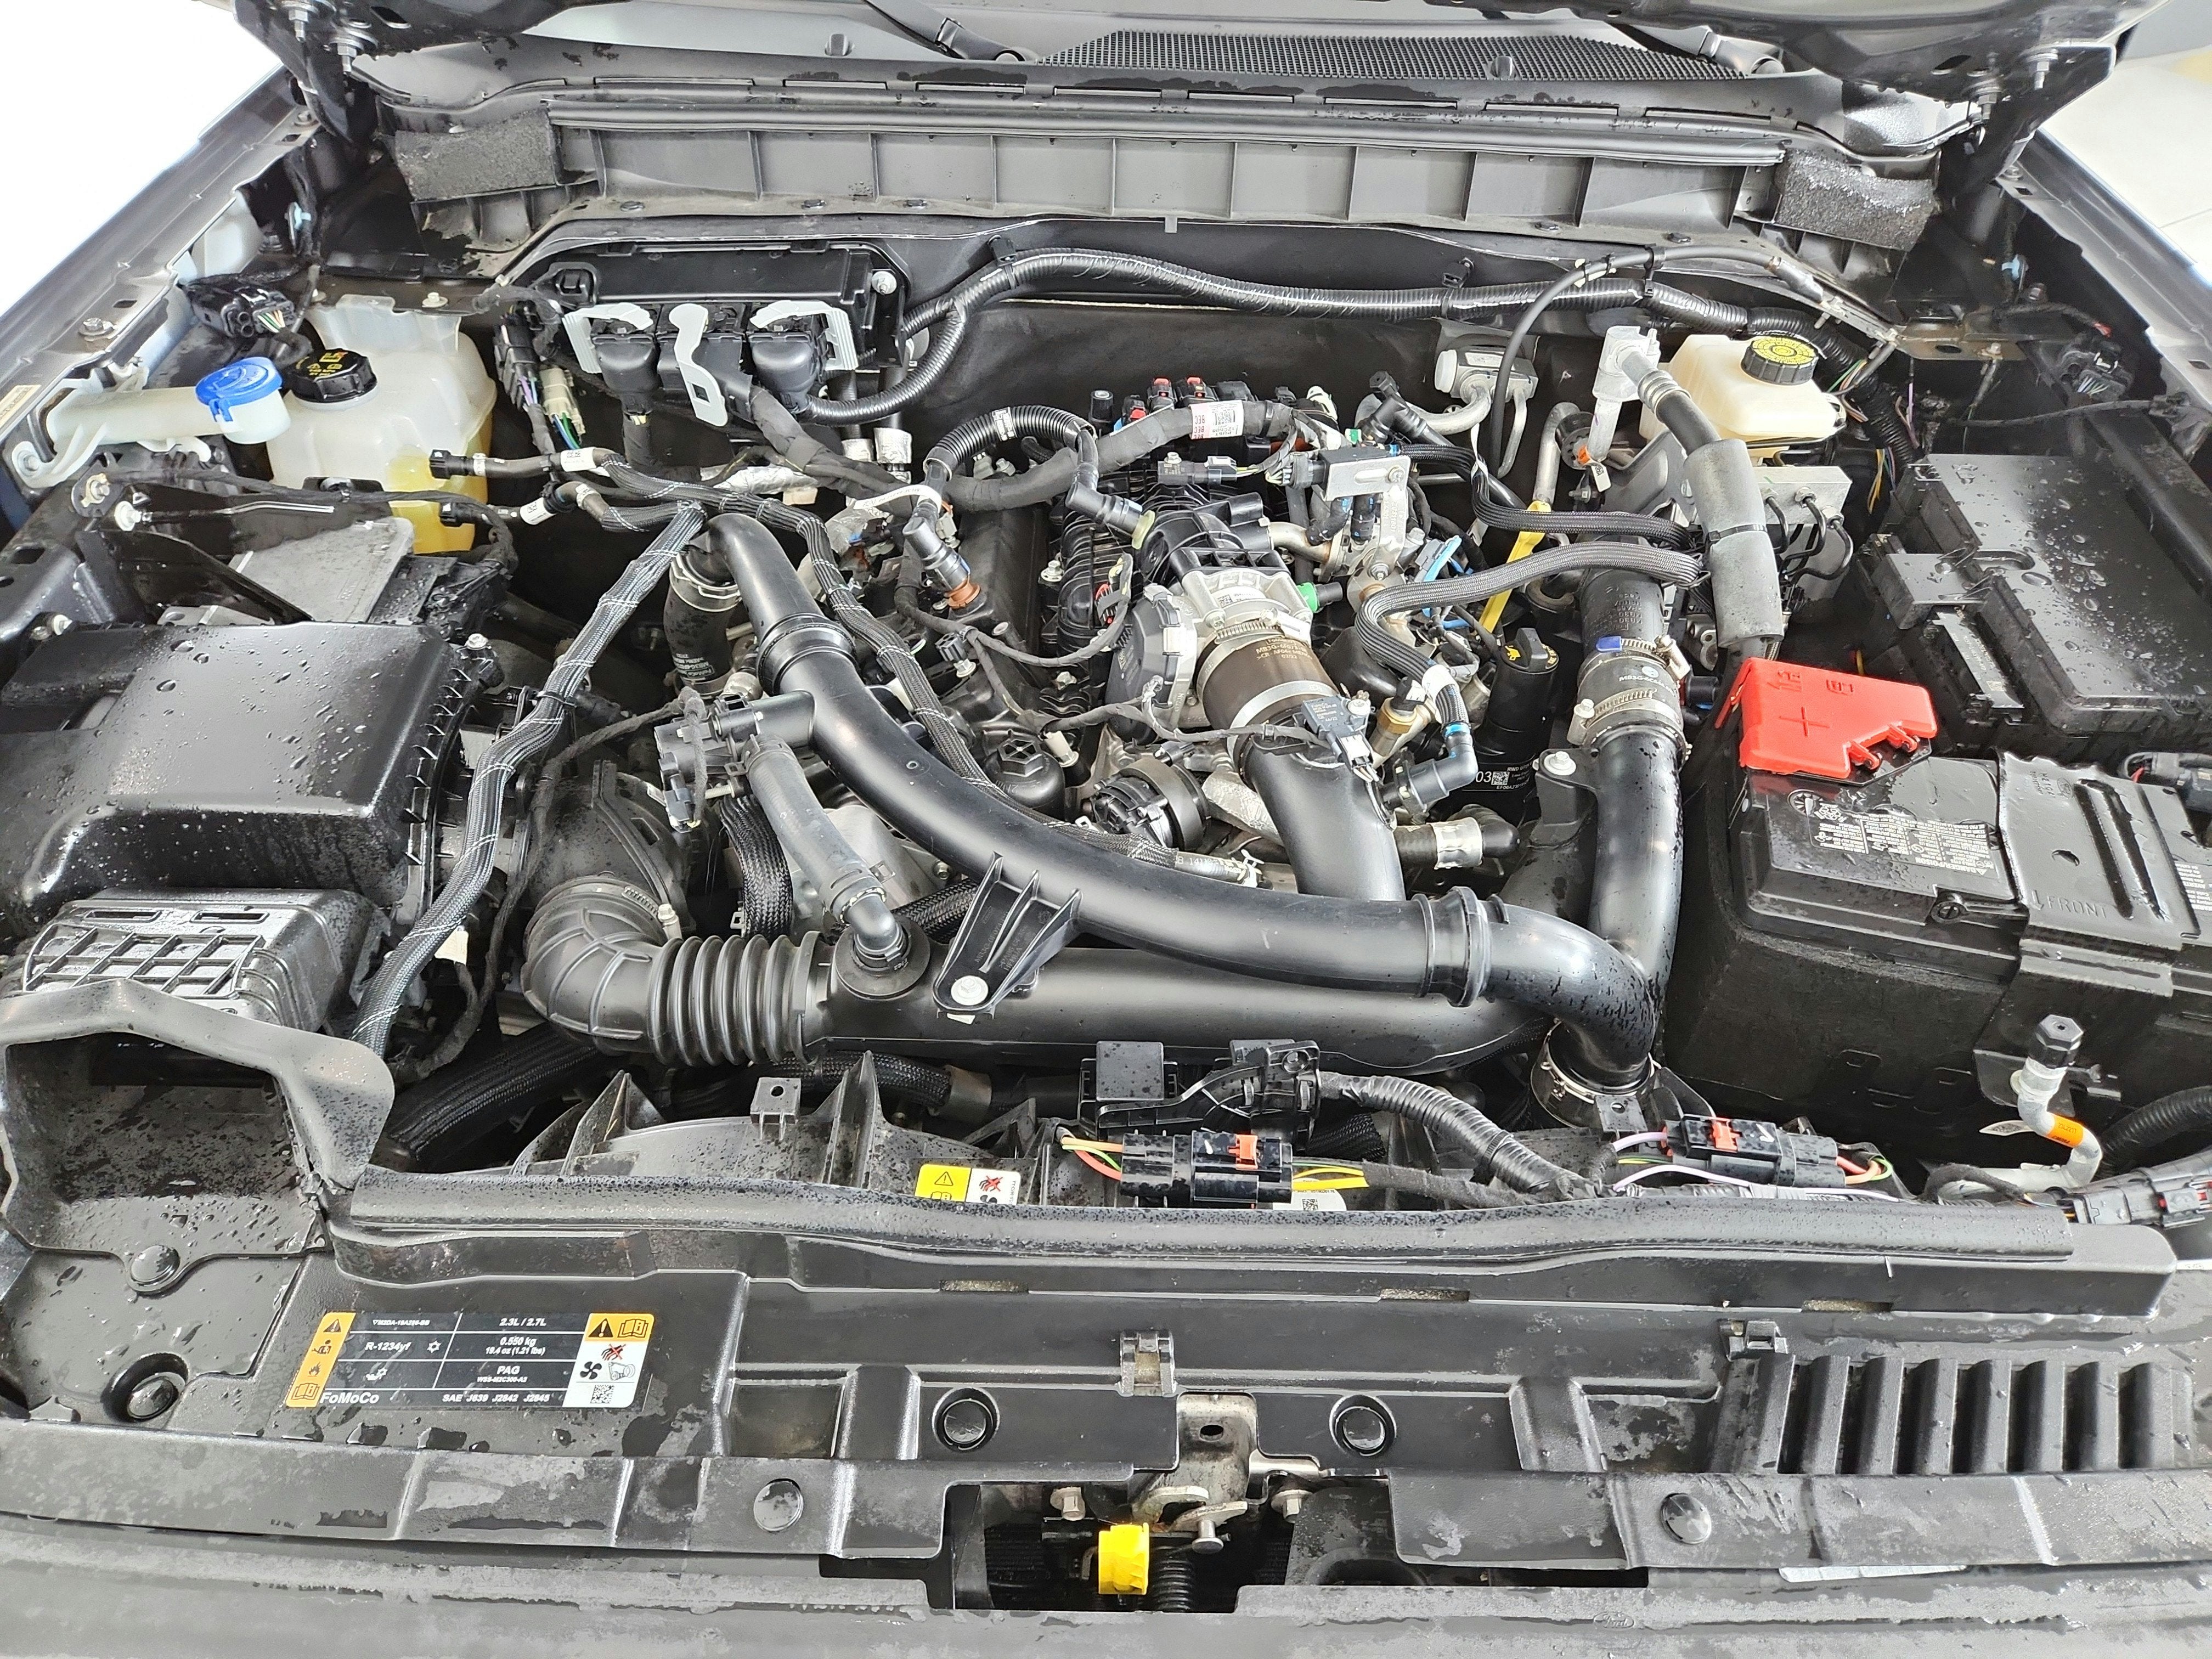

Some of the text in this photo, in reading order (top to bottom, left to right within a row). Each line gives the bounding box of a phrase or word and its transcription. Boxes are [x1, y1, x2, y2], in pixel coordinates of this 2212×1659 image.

[1194, 415, 1205, 424] BEC
[1476, 771, 1492, 783] 03
[1915, 856, 1977, 874] DANGER/POISON
[2047, 895, 2106, 918] FRONT
[499, 1318, 546, 1326] 2.3L / 2.7L
[365, 1341, 412, 1352] R-1234yf
[500, 1336, 537, 1347] 0.550 kg
[486, 1346, 501, 1355] 19.4
[512, 1346, 530, 1356] (1.21
[531, 1347, 546, 1356] lbs)
[496, 1365, 520, 1374] PAG
[319, 1392, 380, 1403] FoMoCo
[442, 1394, 550, 1402] SAE J639 J2842 J2845
